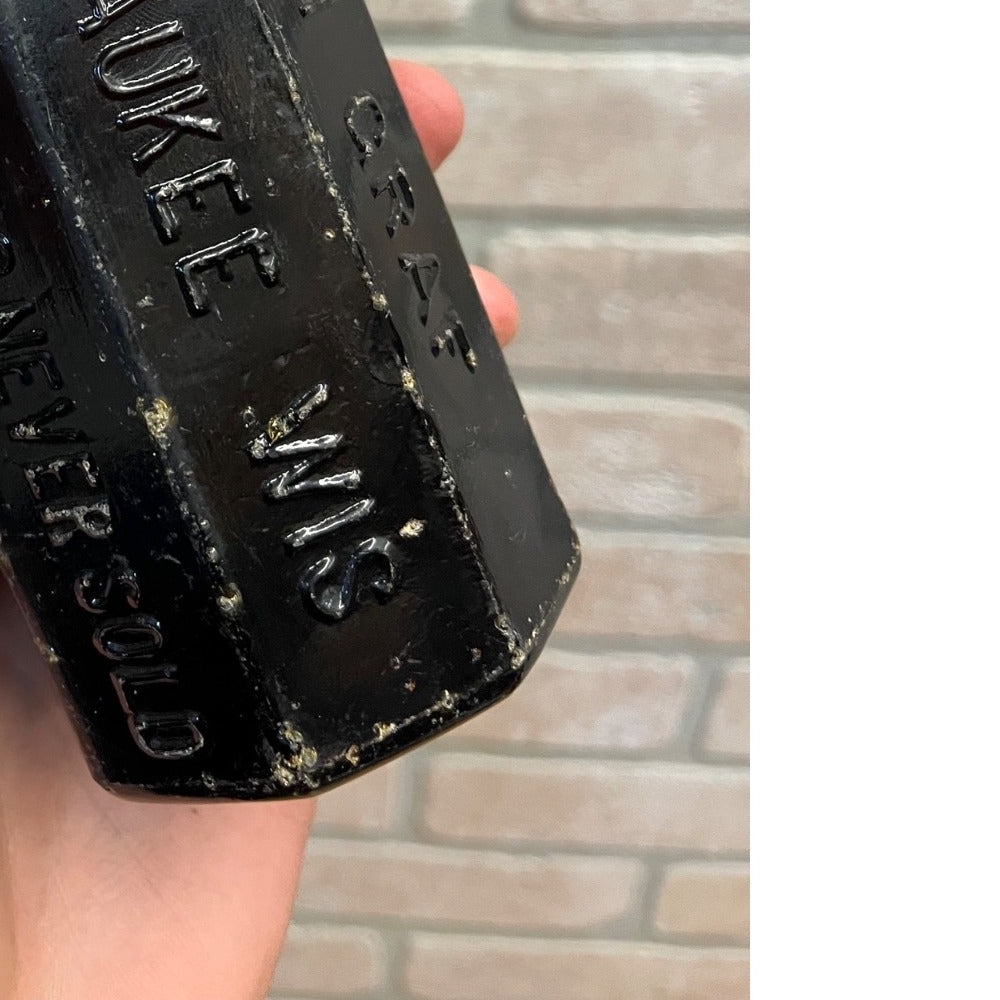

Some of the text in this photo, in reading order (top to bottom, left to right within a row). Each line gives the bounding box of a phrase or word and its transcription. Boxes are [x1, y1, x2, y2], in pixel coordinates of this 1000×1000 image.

[343, 89, 479, 375] GRAF
[246, 382, 402, 626] WIS
[73, 552, 206, 762] SOLD
